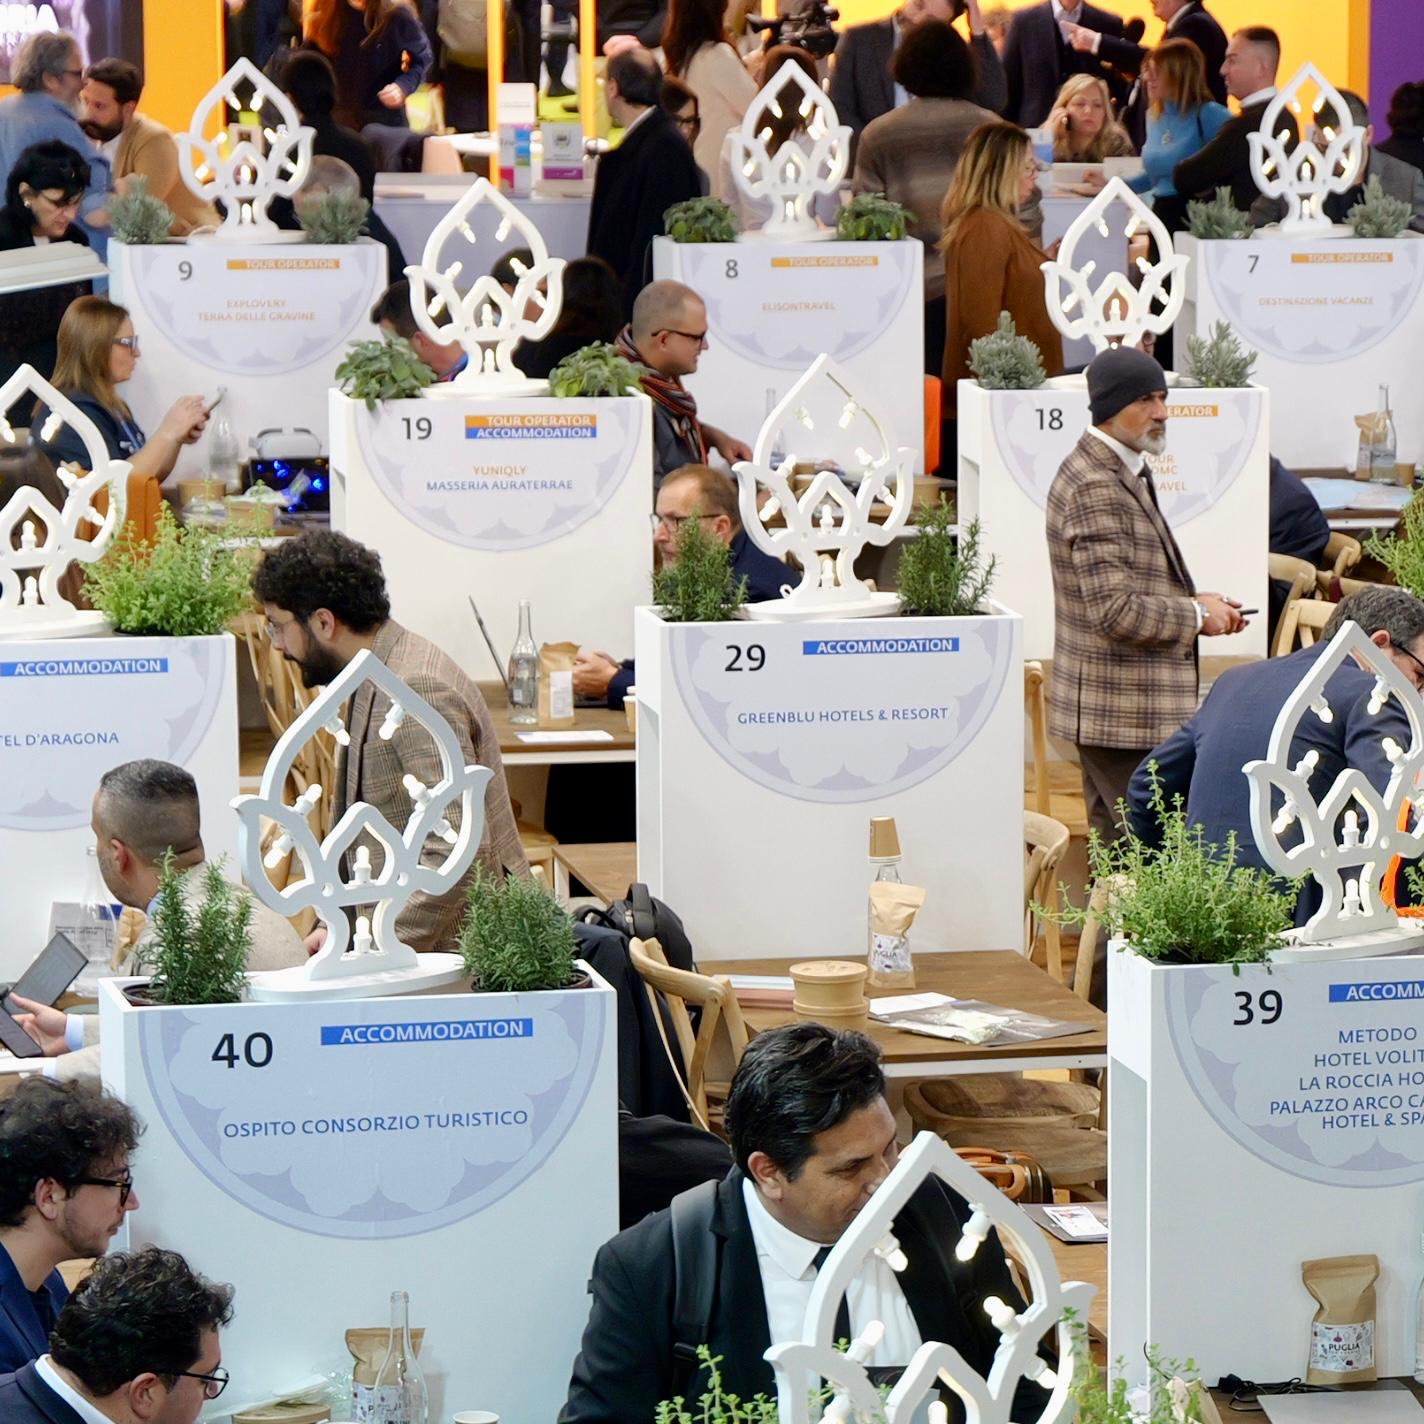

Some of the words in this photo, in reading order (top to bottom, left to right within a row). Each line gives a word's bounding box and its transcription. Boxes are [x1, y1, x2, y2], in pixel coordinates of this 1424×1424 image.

[178, 260, 193, 281] 9
[725, 259, 739, 278] 8
[1248, 255, 1260, 274] 7
[1035, 408, 1063, 430] 18
[1167, 406, 1213, 416] ERATOR
[401, 416, 432, 440] 19
[487, 416, 521, 427] TOUR
[524, 415, 591, 426] OPERATOR
[476, 427, 591, 438] ACCOMMODATION
[473, 465, 527, 476] YUNIQLY
[427, 481, 489, 491] MASSERIA
[491, 480, 573, 490] AURATERRAE
[1156, 481, 1186, 491] AVEL
[817, 639, 953, 654] ACCOMMODATION
[724, 644, 766, 672] 29
[14, 659, 161, 675] ACCOMMODATION
[738, 711, 815, 724] GREENBLU
[820, 709, 874, 722] HOTELS
[878, 709, 888, 721] &
[891, 707, 949, 720] RESORT
[26, 732, 119, 746] D'ARAGONA
[1233, 989, 1283, 1026] 39
[340, 1020, 525, 1044] ACCOMMODATION
[1338, 1027, 1417, 1044] METODO
[211, 1031, 274, 1069] 40
[1314, 1051, 1372, 1068] HOTEL
[1299, 1076, 1320, 1091] LA
[1326, 1073, 1393, 1089] ROCCIA
[1270, 1098, 1349, 1115] PALAZZO
[1353, 1095, 1403, 1110] ARCO
[223, 1121, 296, 1138] OSPITO
[302, 1115, 420, 1134] CONSORZIO
[424, 1110, 528, 1128] TURISTICO
[1322, 1113, 1380, 1130] HOTEL
[1384, 1113, 1396, 1126] &
[1329, 1343, 1360, 1352] PUGLIA
